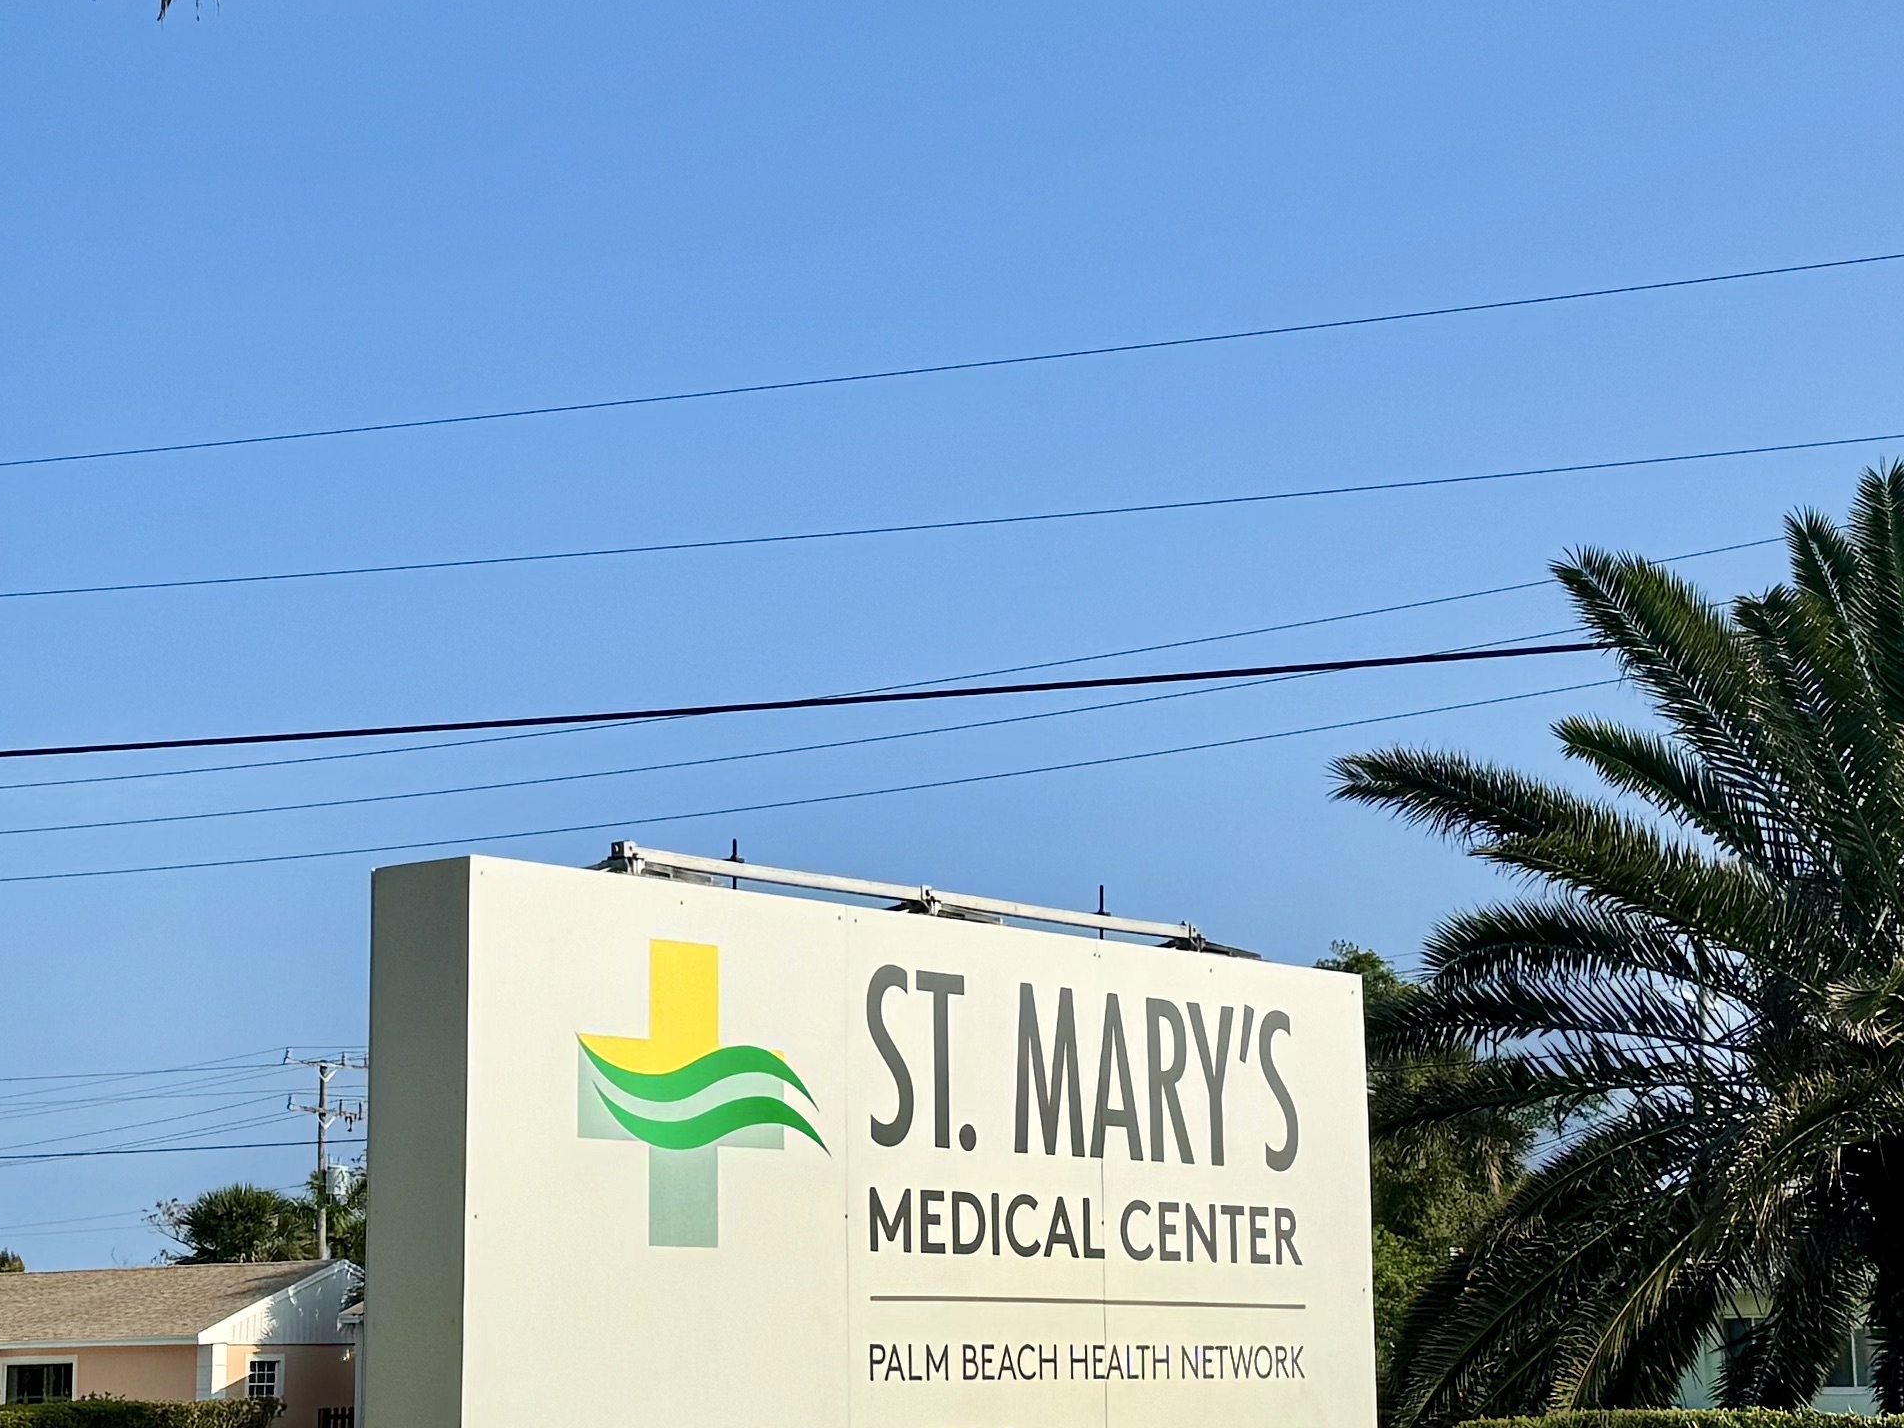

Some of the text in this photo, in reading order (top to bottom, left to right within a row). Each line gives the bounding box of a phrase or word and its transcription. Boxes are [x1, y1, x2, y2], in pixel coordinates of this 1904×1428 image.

[866, 964, 1299, 1172] ST. MARY'S
[869, 1186, 1303, 1266] MEDICAL CENTER
[869, 1343, 1306, 1382] PALM BEACH HEALTH NETWORK
